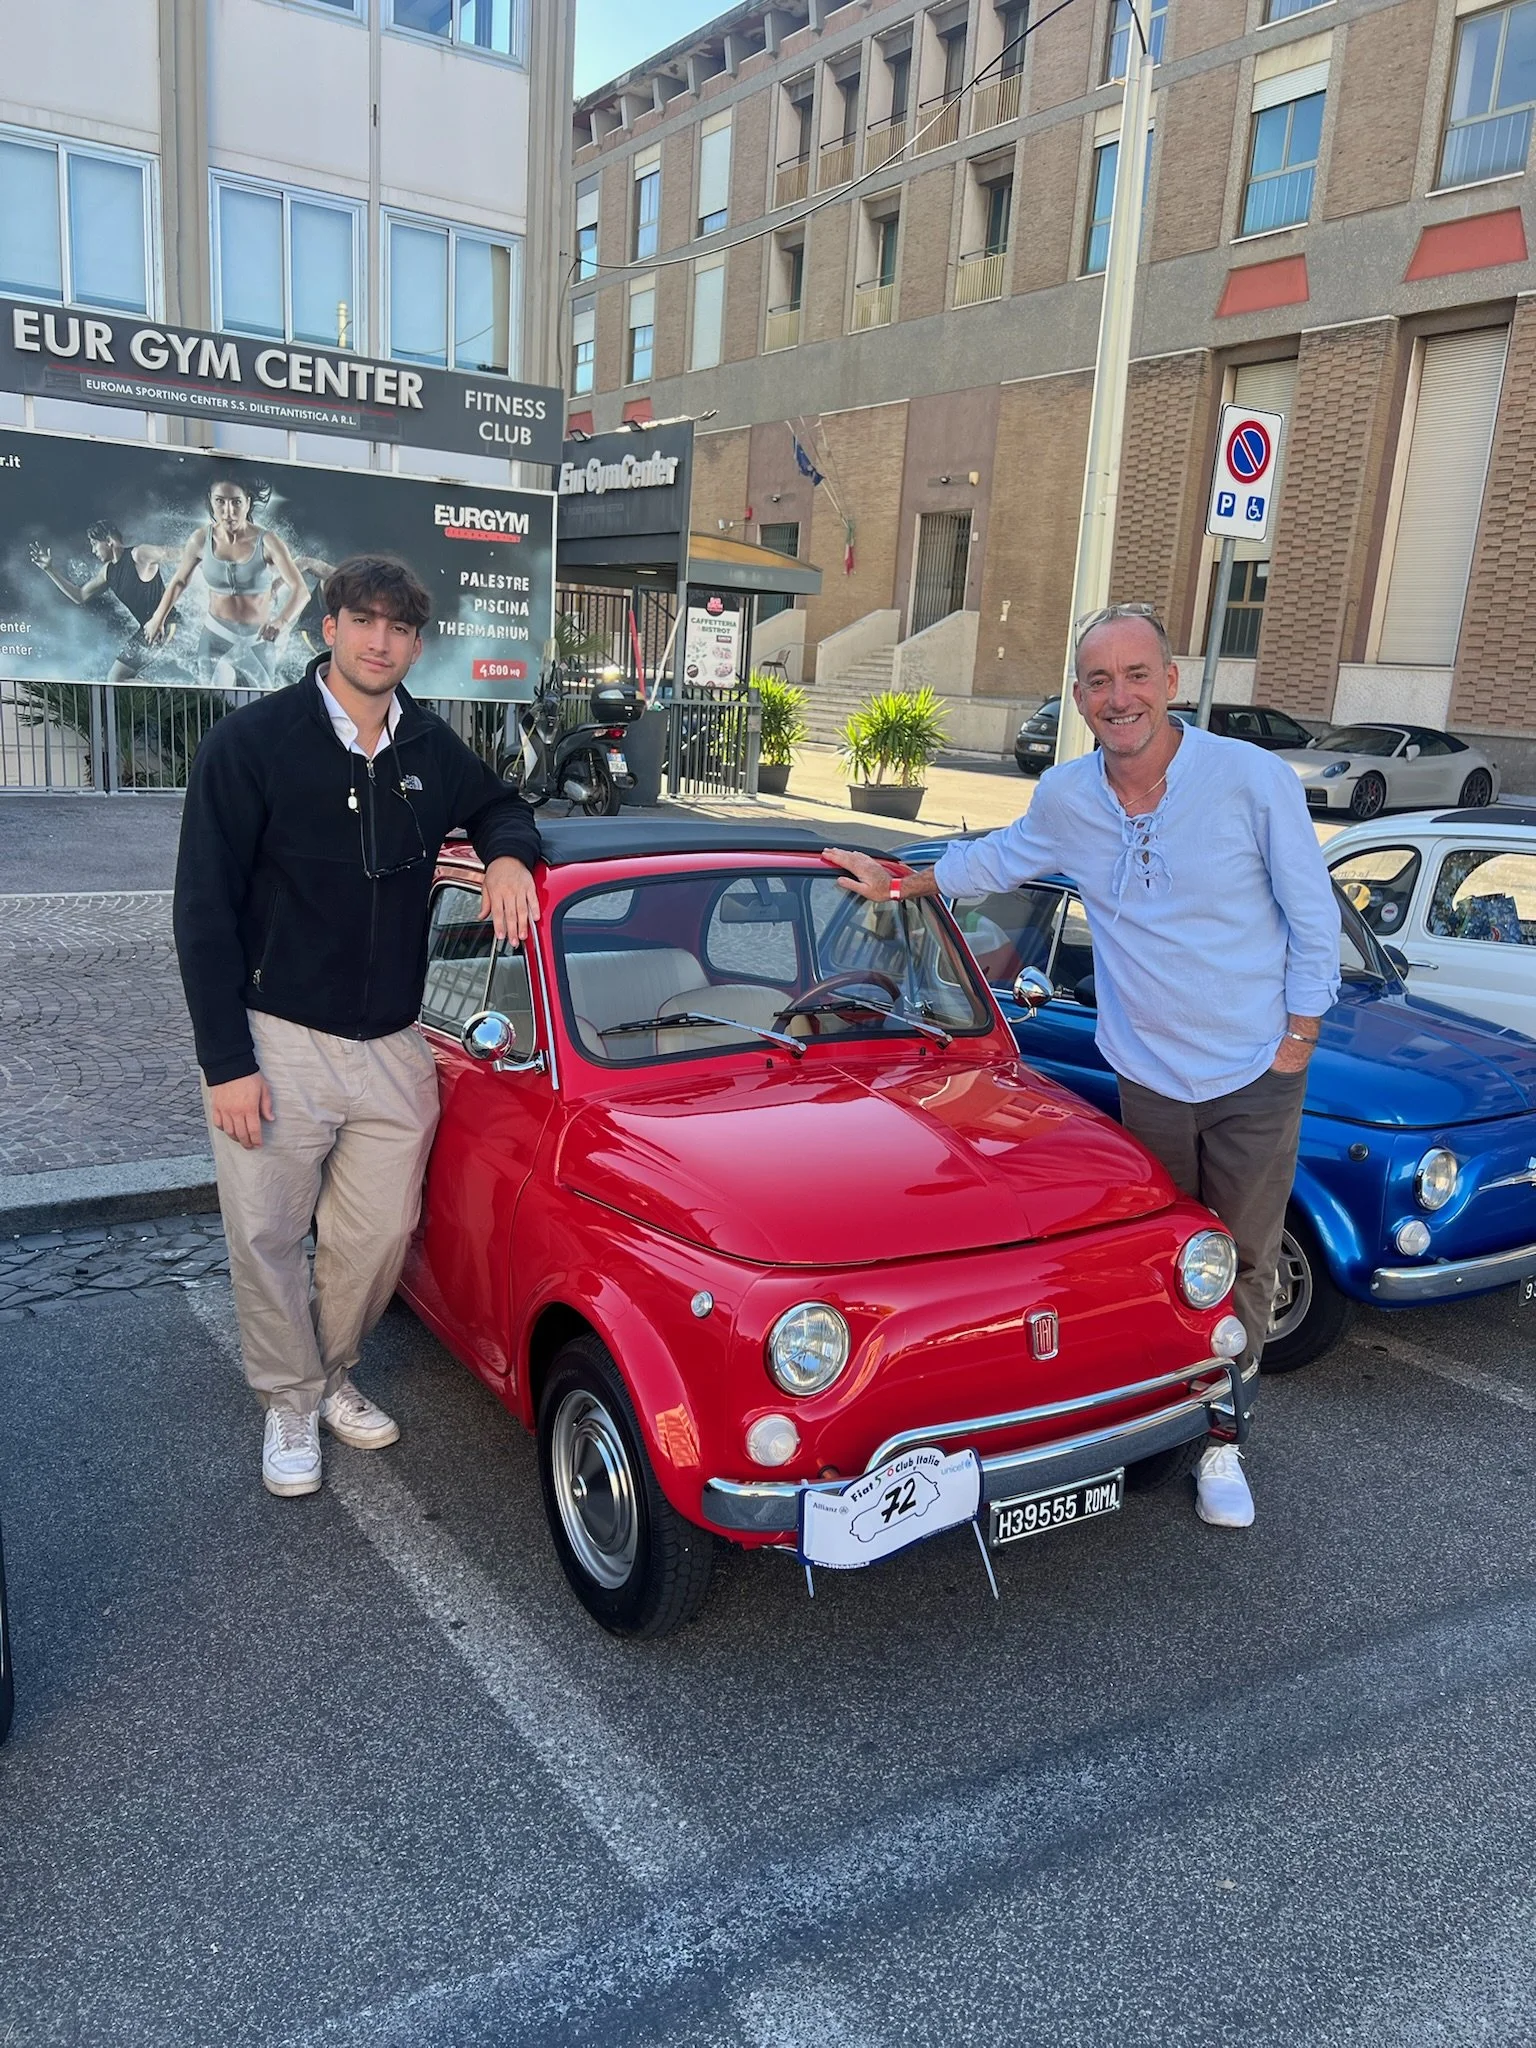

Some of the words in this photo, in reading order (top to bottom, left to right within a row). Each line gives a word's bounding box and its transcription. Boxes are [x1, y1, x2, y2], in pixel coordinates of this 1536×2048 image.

[13, 308, 115, 363] EUR
[129, 329, 242, 382] GYM
[254, 349, 424, 409] CENTER
[86, 379, 133, 395] EUROMA
[135, 387, 188, 402] SPORTING
[190, 394, 229, 409] CENTER
[230, 400, 248, 411] S.S.
[249, 403, 329, 422] DILETTANTISTICA
[331, 414, 341, 423] A
[341, 415, 357, 426] R.L.
[465, 389, 546, 420] FITNESS
[478, 421, 532, 446] CLUB
[1219, 493, 1234, 515] P
[434, 504, 529, 535] EURGYM
[460, 571, 530, 592] PALESTRE
[474, 598, 529, 617] PISCINA
[438, 621, 529, 641] THERMARIUM
[691, 617, 737, 628] CAFFETTERIA
[701, 625, 731, 634] BISTROT
[480, 663, 509, 678] 4.600
[1035, 1318, 1053, 1353] FIAT
[850, 1482, 874, 1503] Fiat
[895, 1456, 914, 1473] Club
[916, 1454, 941, 1468] Italia
[940, 1460, 965, 1476] unicef
[812, 1502, 838, 1514] Allianz
[881, 1477, 917, 1524] 72
[998, 1493, 1078, 1539] H39555
[1084, 1482, 1119, 1515] ROMA
